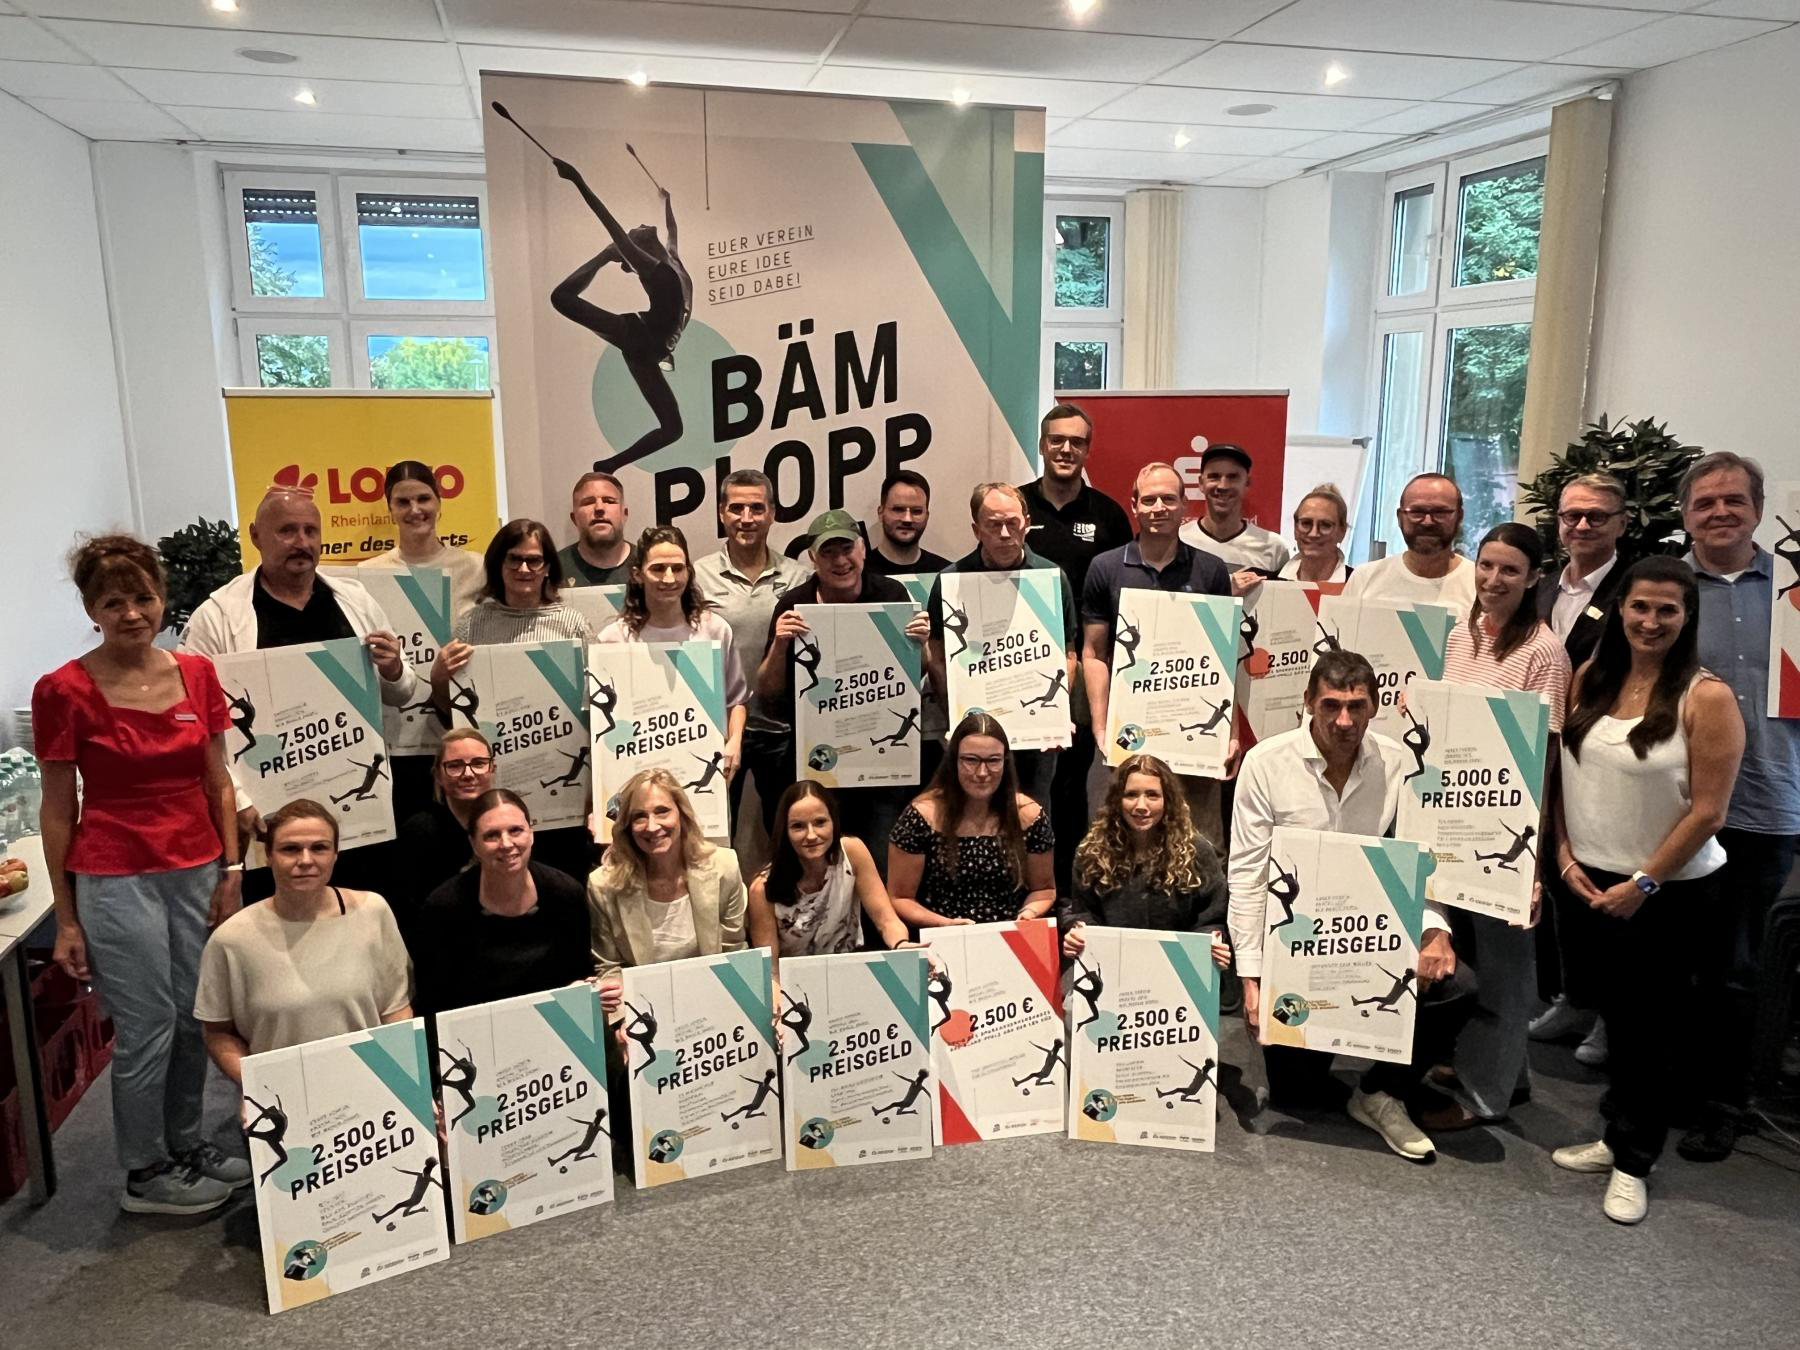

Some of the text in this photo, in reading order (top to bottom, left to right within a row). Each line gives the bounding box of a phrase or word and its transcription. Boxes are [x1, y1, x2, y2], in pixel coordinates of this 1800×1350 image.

[708, 225, 812, 256] EUER VEREIN
[708, 251, 790, 279] EURE IDEE
[708, 272, 800, 302] SEID DABEI
[712, 318, 898, 443] BÄM
[328, 465, 464, 504] LOO
[360, 536, 395, 552] des
[983, 630, 1039, 656] 2.500 €
[1268, 650, 1308, 668] 2.500
[968, 644, 1050, 677] PREISGELD
[1150, 656, 1210, 675] 2.500 €
[834, 667, 894, 692] 2.500 €
[1132, 672, 1220, 694] PREISGELD
[818, 682, 906, 714] PREISGELD
[278, 718, 329, 750] 7.500
[335, 712, 348, 727] €
[496, 710, 542, 738] 2.500
[548, 706, 560, 720] €
[632, 708, 695, 736] 2.500 €
[260, 726, 364, 778] PREISGELD
[492, 721, 572, 758] REISGELD
[616, 724, 708, 760] PREISGELD
[1441, 768, 1510, 787] 5.000 €
[1422, 790, 1522, 808] PREISGELD
[1312, 914, 1388, 935] 2.500 €
[1291, 934, 1402, 957] PREISGELD
[970, 1002, 1016, 1032] 2.500
[1022, 997, 1034, 1013] €
[1118, 1006, 1188, 1030] 2.500 €
[675, 1032, 726, 1066] 2.500
[733, 1026, 744, 1042] €
[828, 1024, 898, 1057] 2.500 €
[1097, 1026, 1200, 1053] PREISGELD
[658, 1042, 758, 1094] PREISGELD
[810, 1040, 912, 1083] PREISGELD
[497, 1074, 554, 1112] 2.500
[560, 1066, 572, 1083] €
[477, 1080, 588, 1144] PREISGELD
[312, 1120, 375, 1166] 2.500
[382, 1110, 396, 1129] €
[290, 1128, 414, 1200] PREISGELD
